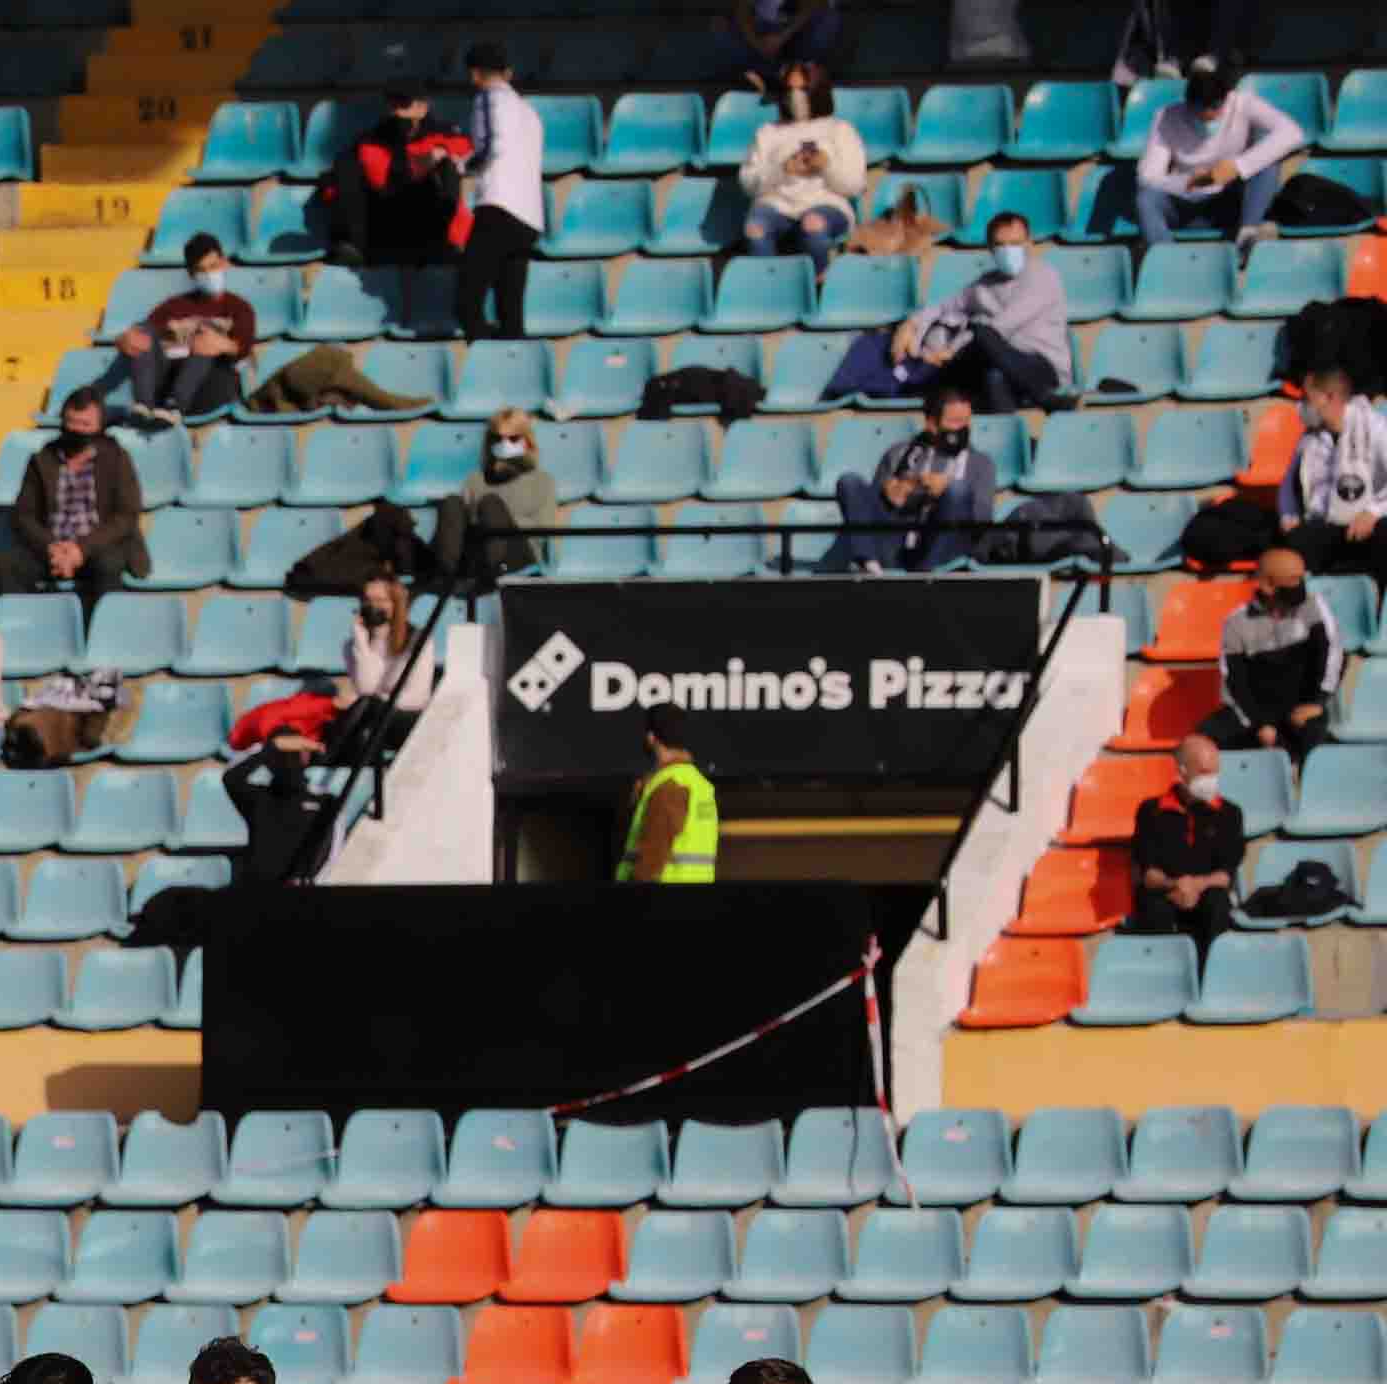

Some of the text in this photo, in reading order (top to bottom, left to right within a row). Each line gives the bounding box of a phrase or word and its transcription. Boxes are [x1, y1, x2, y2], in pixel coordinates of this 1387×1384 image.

[95, 197, 130, 223] 19
[42, 276, 76, 300] 18
[590, 656, 854, 713] Domino's
